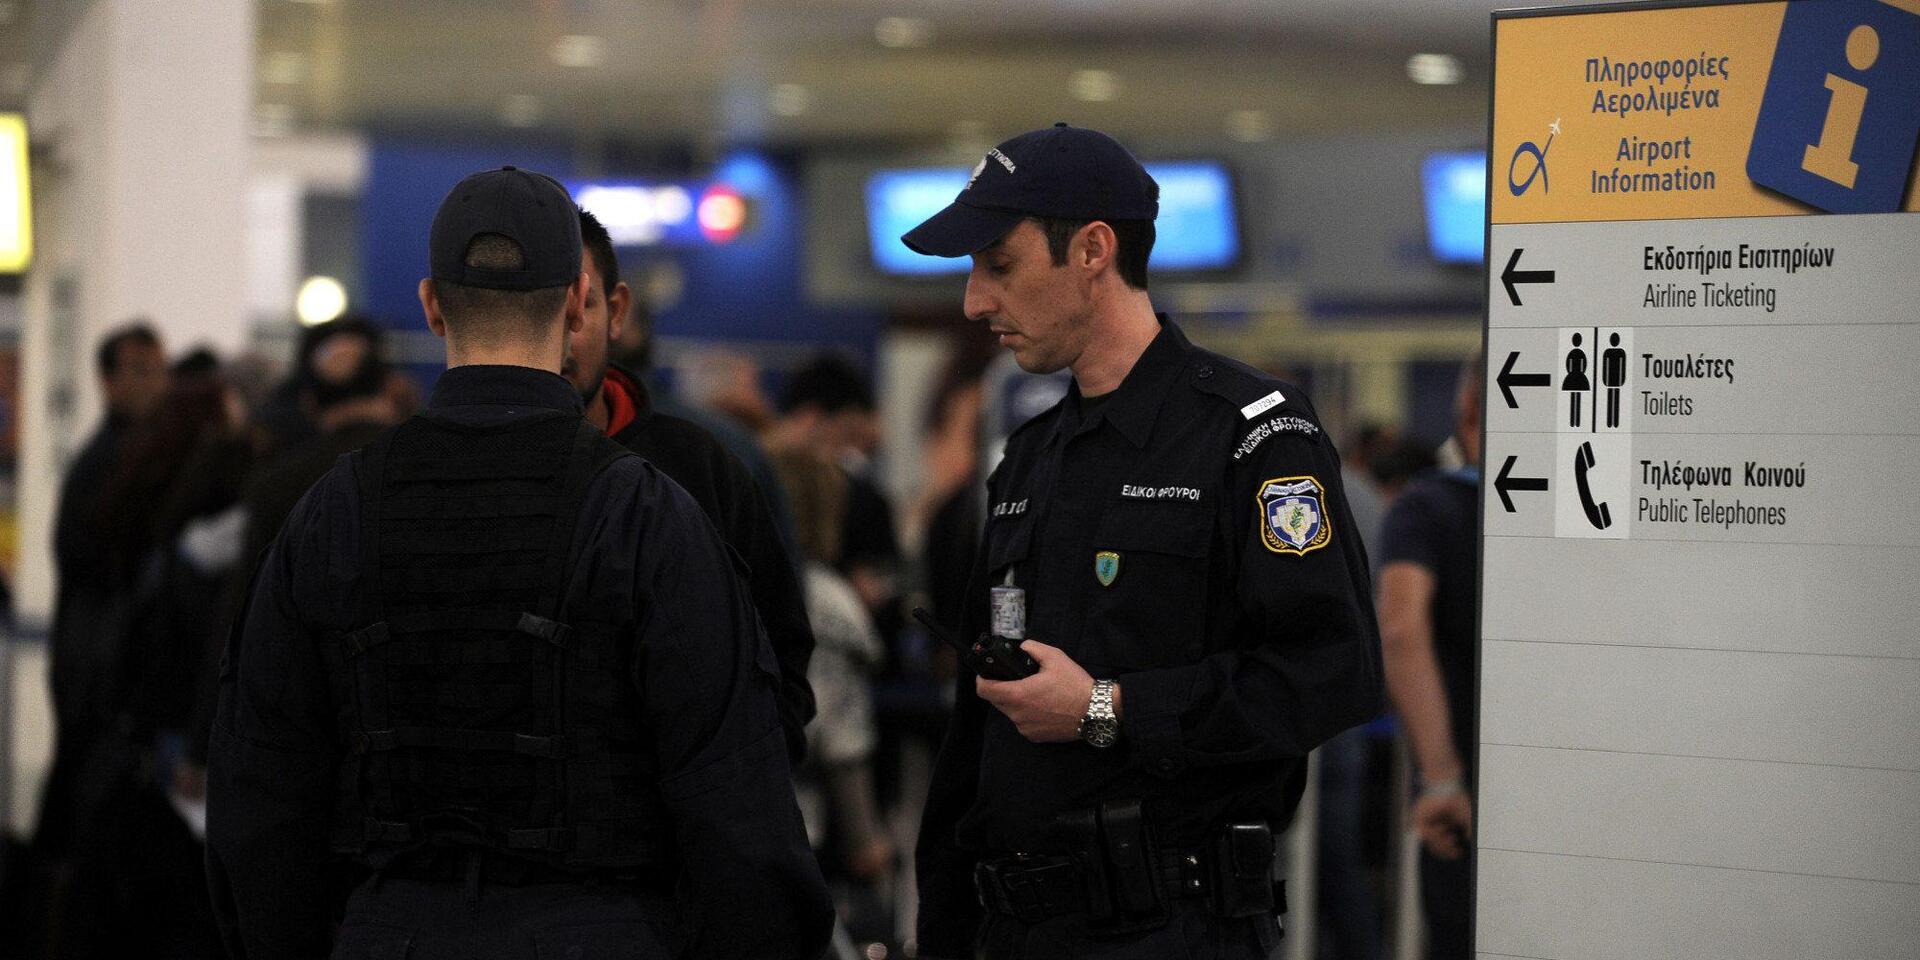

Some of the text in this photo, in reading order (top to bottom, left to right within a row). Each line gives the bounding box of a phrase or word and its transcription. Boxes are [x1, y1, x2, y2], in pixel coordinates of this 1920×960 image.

[1585, 52, 1729, 87] Πληροφορίες
[1592, 84, 1720, 118] Αερολιμένα
[1616, 136, 1691, 166] Airport
[1591, 166, 1716, 194] Information
[1643, 243, 1835, 275] Εκδοτήρια Εισιτηρίων
[1643, 283, 1776, 313] Airline Ticketing
[1642, 353, 1735, 383] Τουαλέτες
[1641, 391, 1693, 416] Toilets
[1640, 460, 1805, 491] Τηλέφωνα Κοινού
[1121, 484, 1156, 498] ΕΙΔΙΚΟΙ
[1638, 498, 1786, 525] Public Telephones
